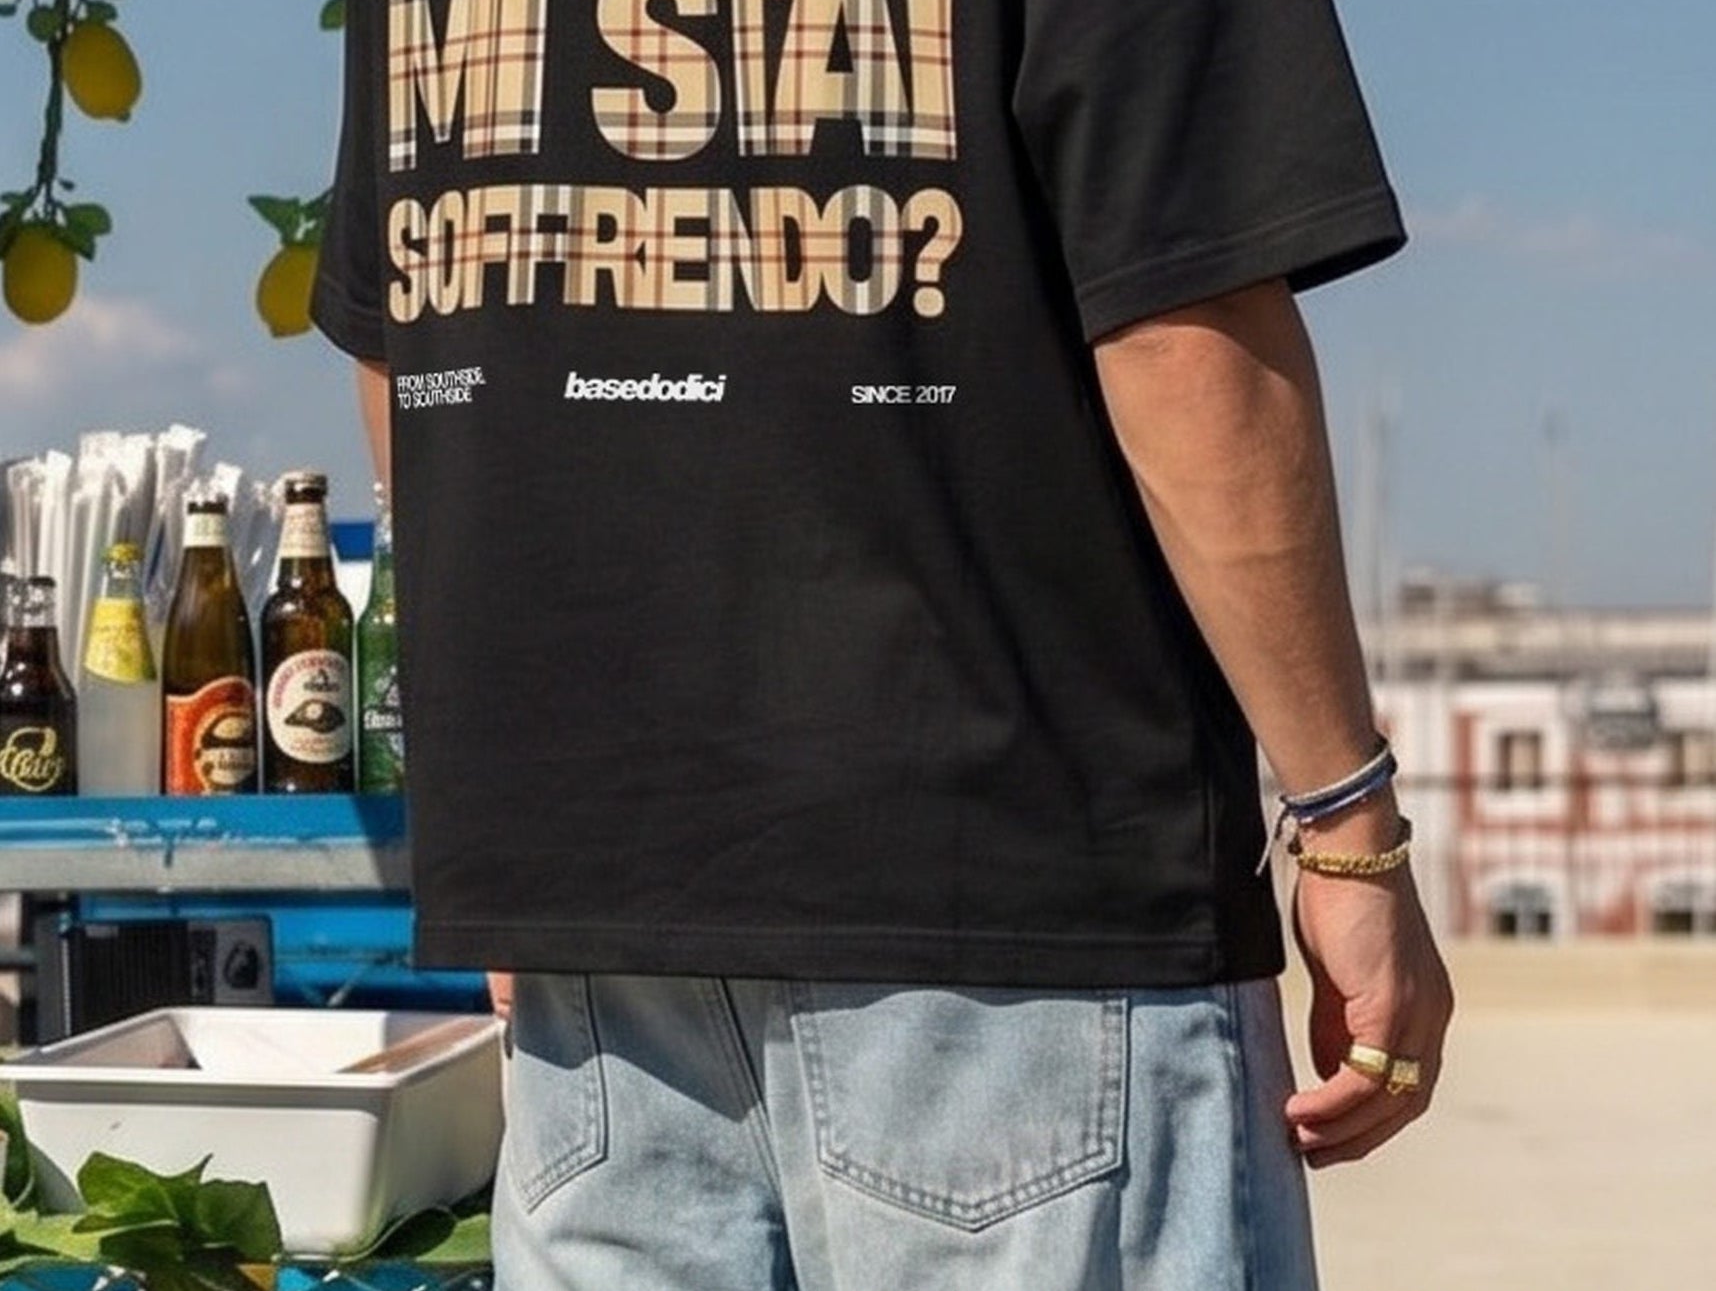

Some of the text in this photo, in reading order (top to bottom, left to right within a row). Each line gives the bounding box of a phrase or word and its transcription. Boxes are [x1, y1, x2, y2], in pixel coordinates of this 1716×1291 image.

[388, 185, 963, 323] SOFFRENDO?
[397, 366, 487, 392] FROM SOUTHSIDE
[564, 371, 727, 402] basedodici
[398, 387, 472, 410] TO SOUTHSIDE
[851, 385, 957, 404] SINCE 2017
